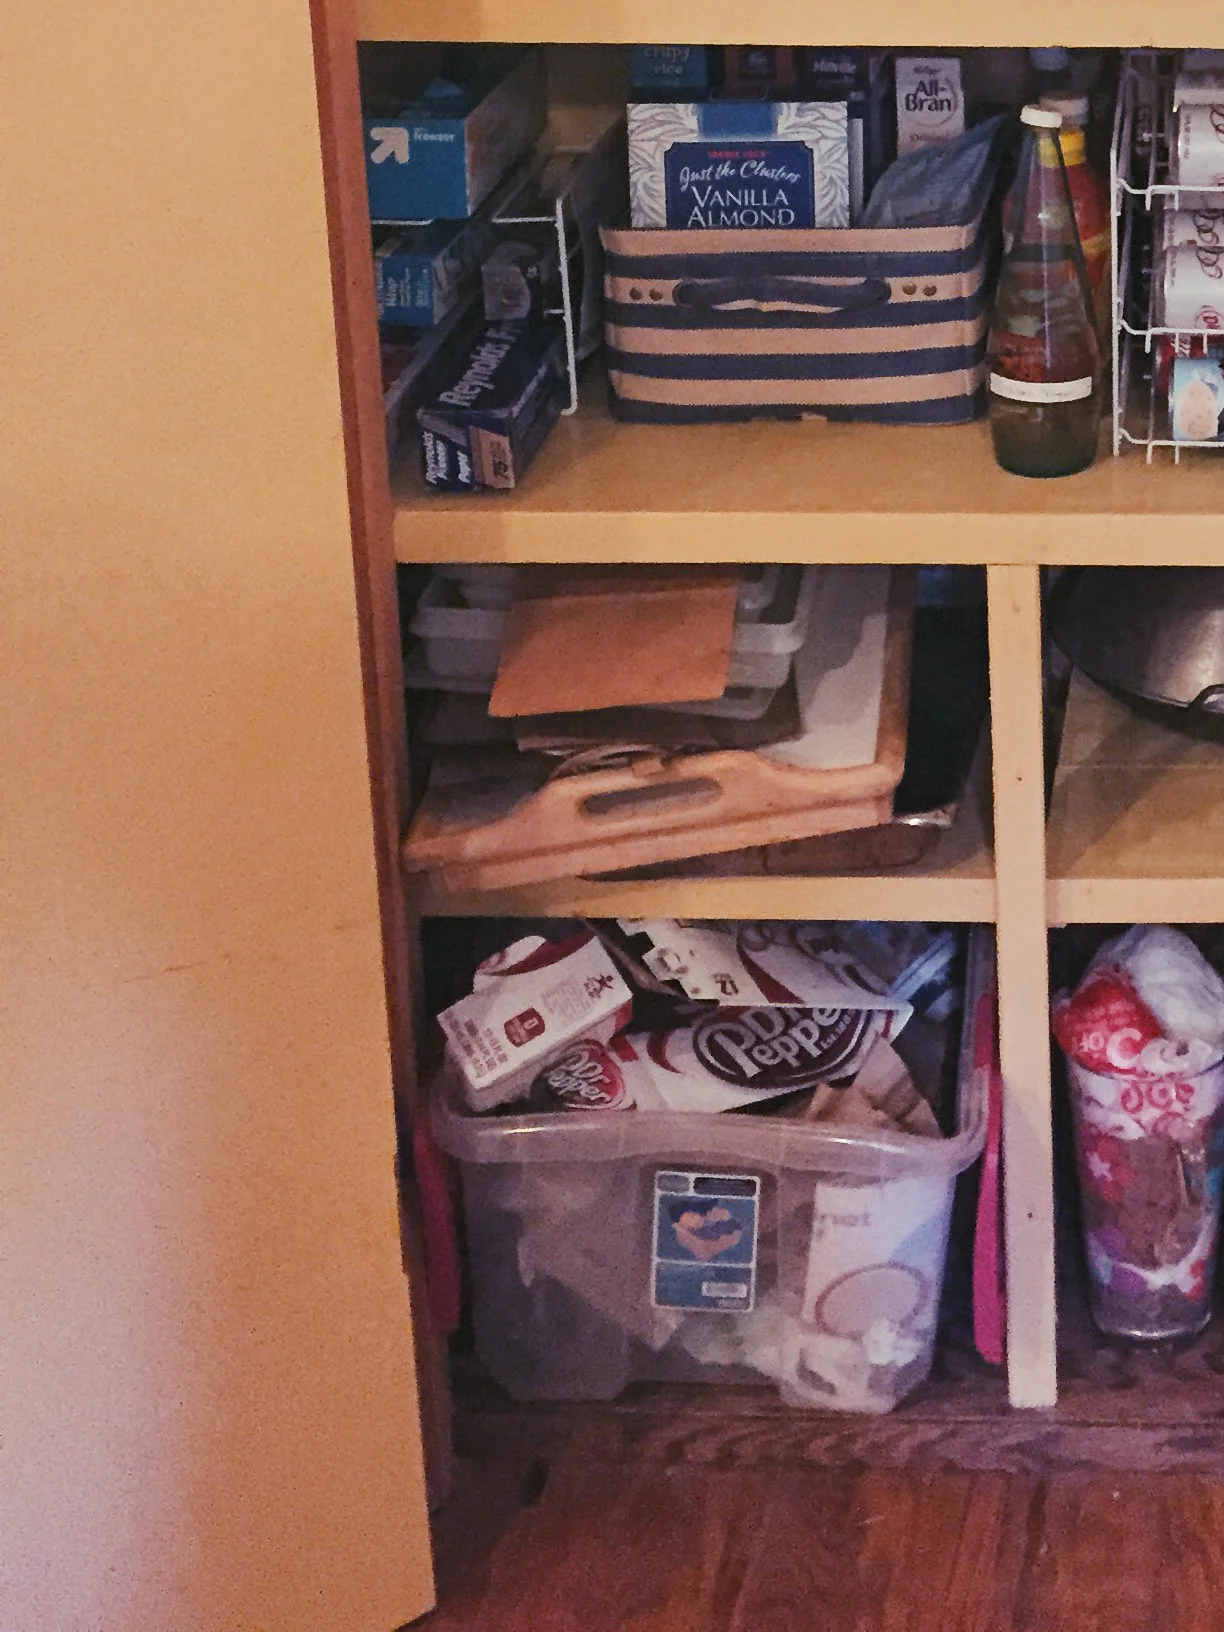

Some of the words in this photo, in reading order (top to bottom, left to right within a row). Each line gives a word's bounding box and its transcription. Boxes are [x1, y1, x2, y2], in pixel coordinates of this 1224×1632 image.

[914, 78, 947, 98] All-
[904, 92, 952, 113] Bran
[679, 164, 713, 192] Just
[714, 159, 736, 180] the
[739, 159, 802, 184] Clusters
[690, 184, 789, 208] VANILLA
[687, 204, 796, 228] ALMOND
[438, 342, 511, 408] Reynolds
[702, 1007, 843, 1078] Peppe
